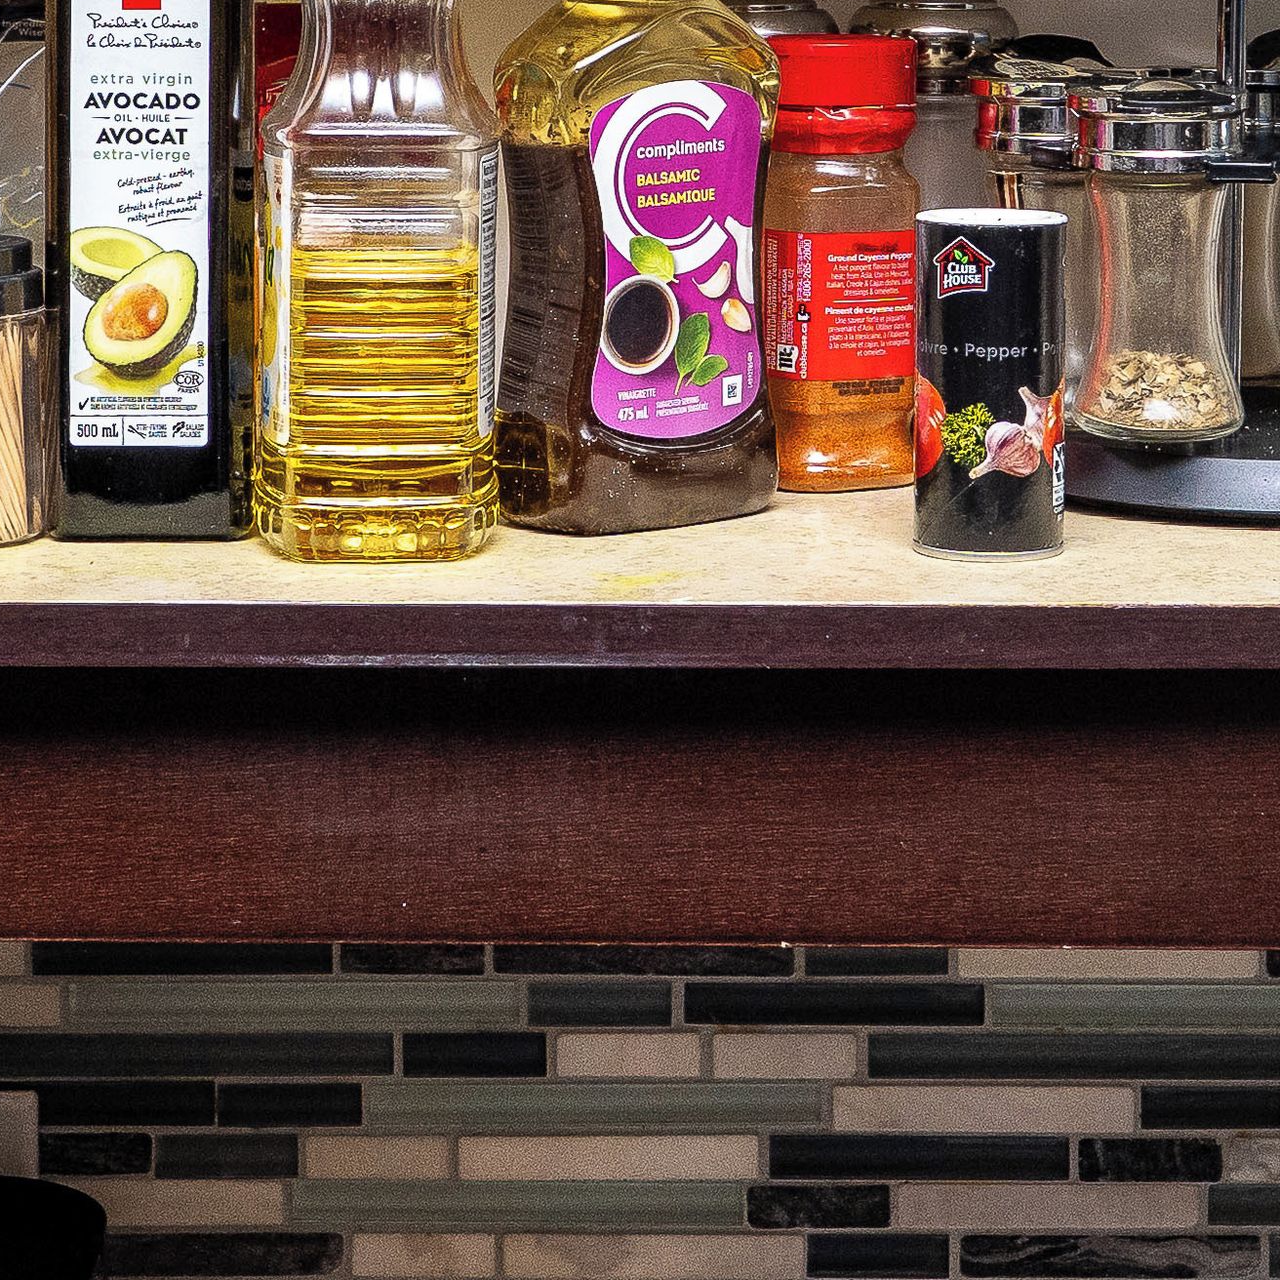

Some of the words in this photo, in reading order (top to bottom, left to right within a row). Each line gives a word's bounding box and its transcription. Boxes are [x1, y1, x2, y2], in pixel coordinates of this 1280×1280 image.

[90, 72, 134, 85] extra
[142, 71, 192, 89] virgin
[83, 92, 201, 110] AVOCADO
[113, 114, 132, 122] OIL
[142, 114, 170, 122] HUILE
[96, 128, 188, 145] AVOCAT
[93, 149, 191, 163] extra-vierge
[636, 138, 726, 159] compliments
[637, 169, 700, 187] BALSAMIC
[638, 188, 716, 208] BALSAMIQUE
[947, 262, 977, 274] CLUB
[943, 274, 982, 289] HOUSE
[965, 343, 1028, 361] Pepper
[77, 424, 97, 437] 500
[102, 423, 118, 437] mL
